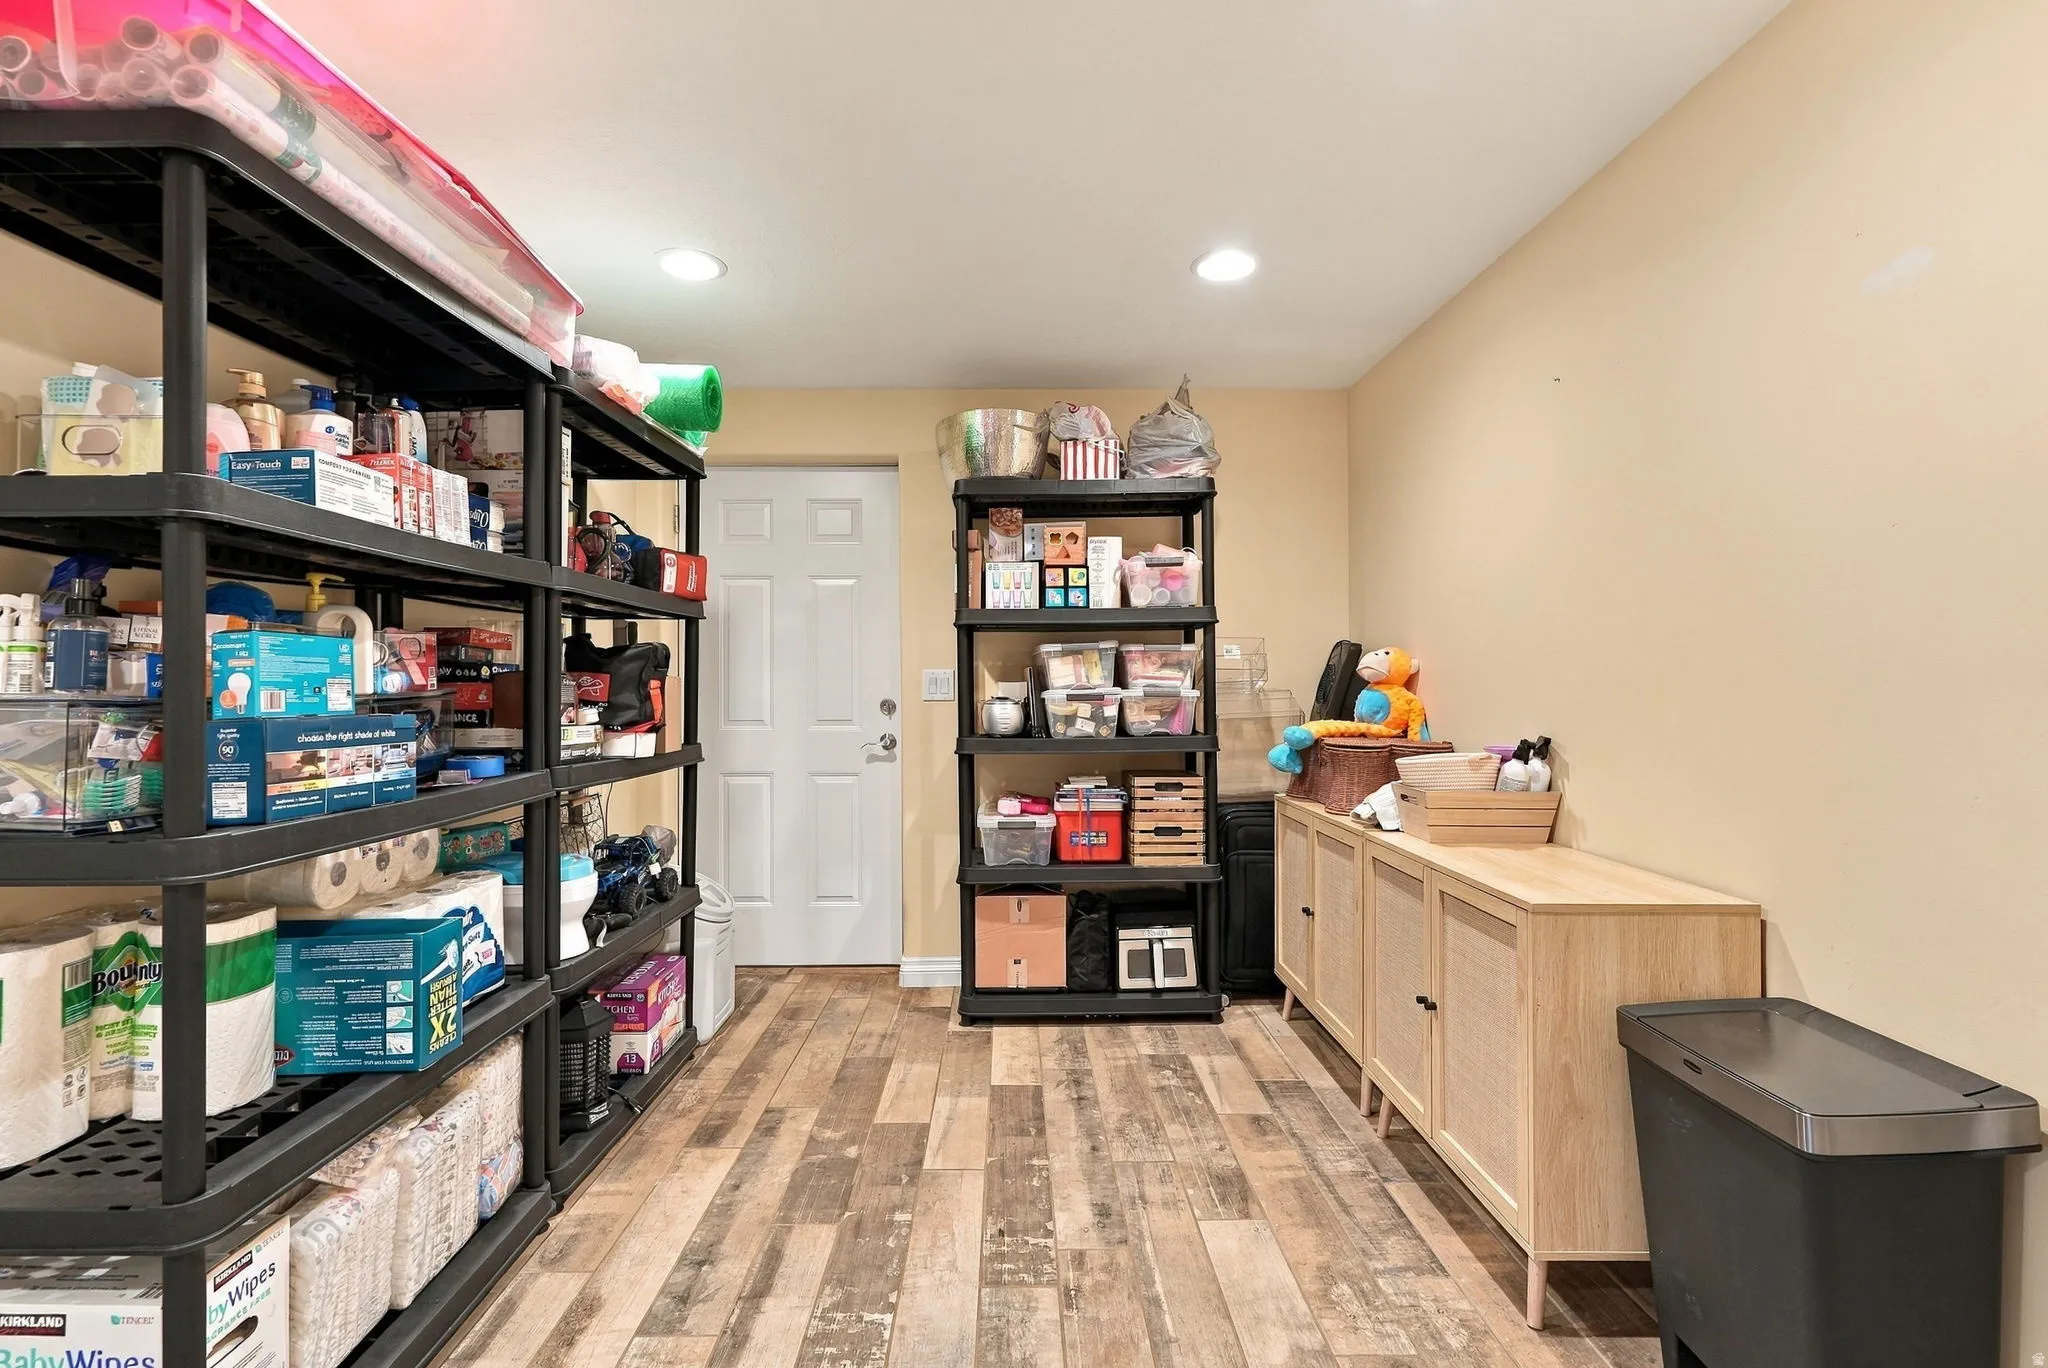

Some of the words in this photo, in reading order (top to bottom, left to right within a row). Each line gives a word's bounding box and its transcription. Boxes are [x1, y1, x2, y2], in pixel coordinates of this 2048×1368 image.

[231, 461, 251, 470] Easy
[255, 460, 282, 468] Touch
[297, 734, 324, 743] choose
[325, 732, 337, 741] the
[338, 732, 353, 742] right
[354, 730, 372, 740] shade
[373, 730, 380, 738] of
[380, 729, 396, 737] white
[222, 746, 234, 754] 90
[92, 962, 162, 996] Bounty
[430, 976, 453, 994] BRUSH
[430, 982, 457, 1006] THAN
[604, 1005, 635, 1014] TCHEN
[430, 1004, 457, 1044] 2X
[429, 1031, 456, 1054] CLEANS
[275, 1050, 289, 1060] CLO
[624, 1054, 636, 1063] 13
[215, 1252, 252, 1284] KIRKLAND
[208, 1262, 276, 1325] byWipes
[0, 1315, 64, 1328] KIRKLAND
[120, 1316, 152, 1325] TENCEL
